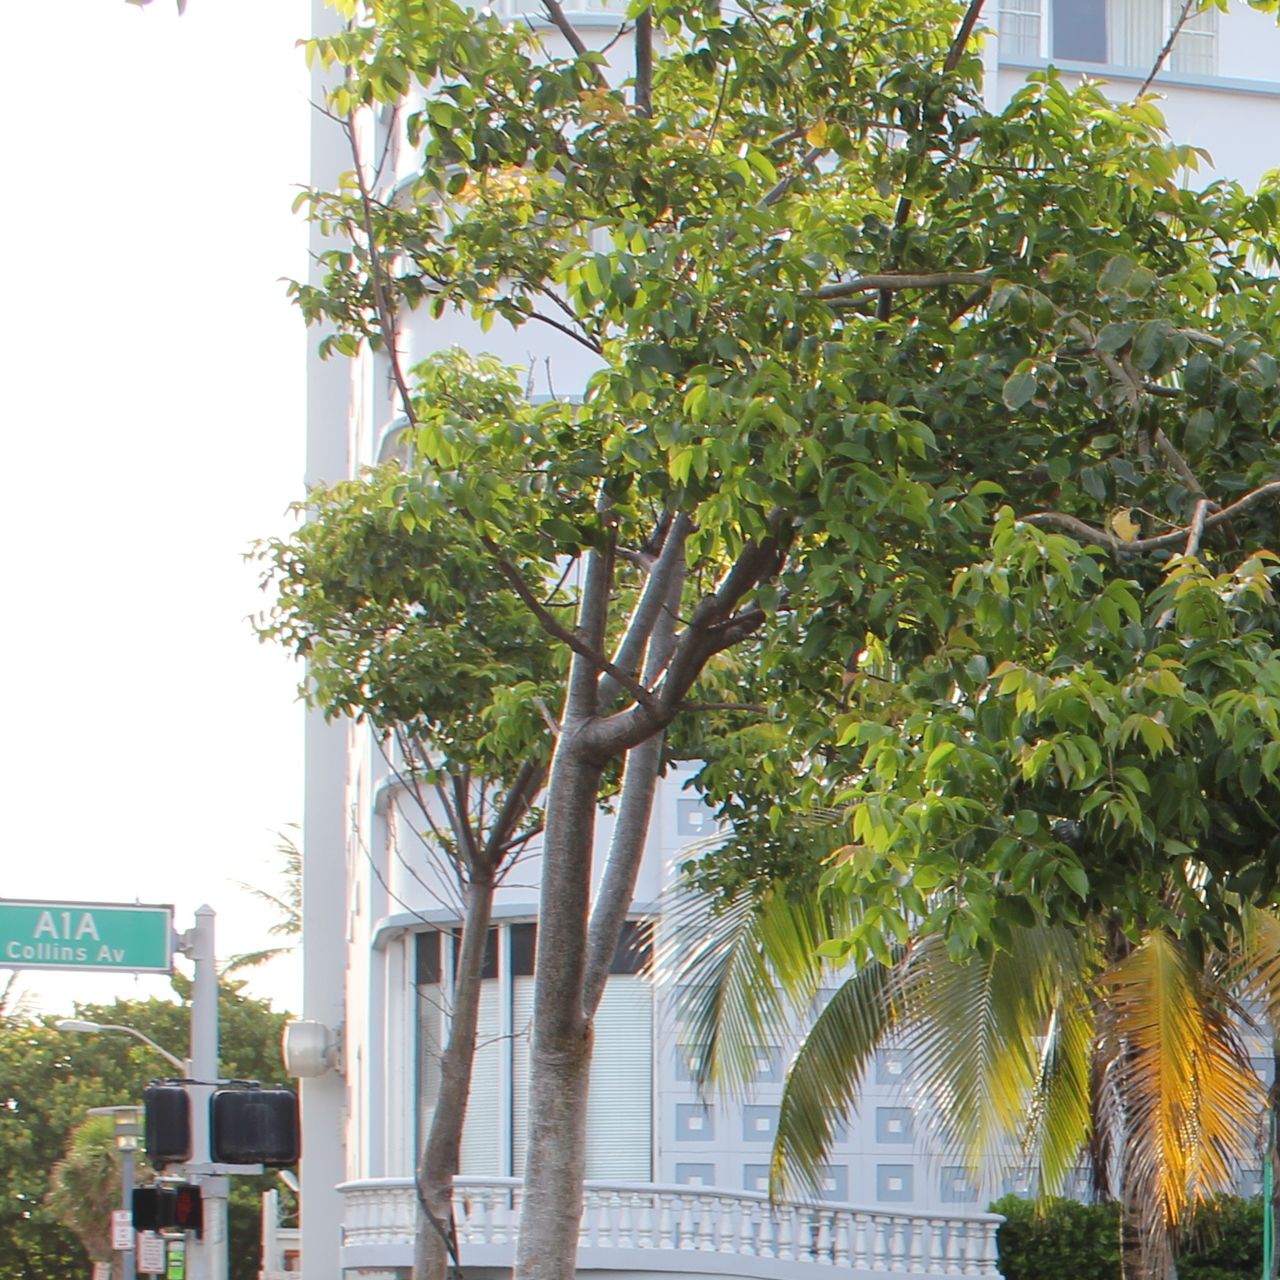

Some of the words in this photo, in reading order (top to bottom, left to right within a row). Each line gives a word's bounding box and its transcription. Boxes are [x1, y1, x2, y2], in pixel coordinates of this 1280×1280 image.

[33, 910, 100, 941] A1A
[6, 941, 88, 961] Collins
[96, 944, 125, 962] Av
